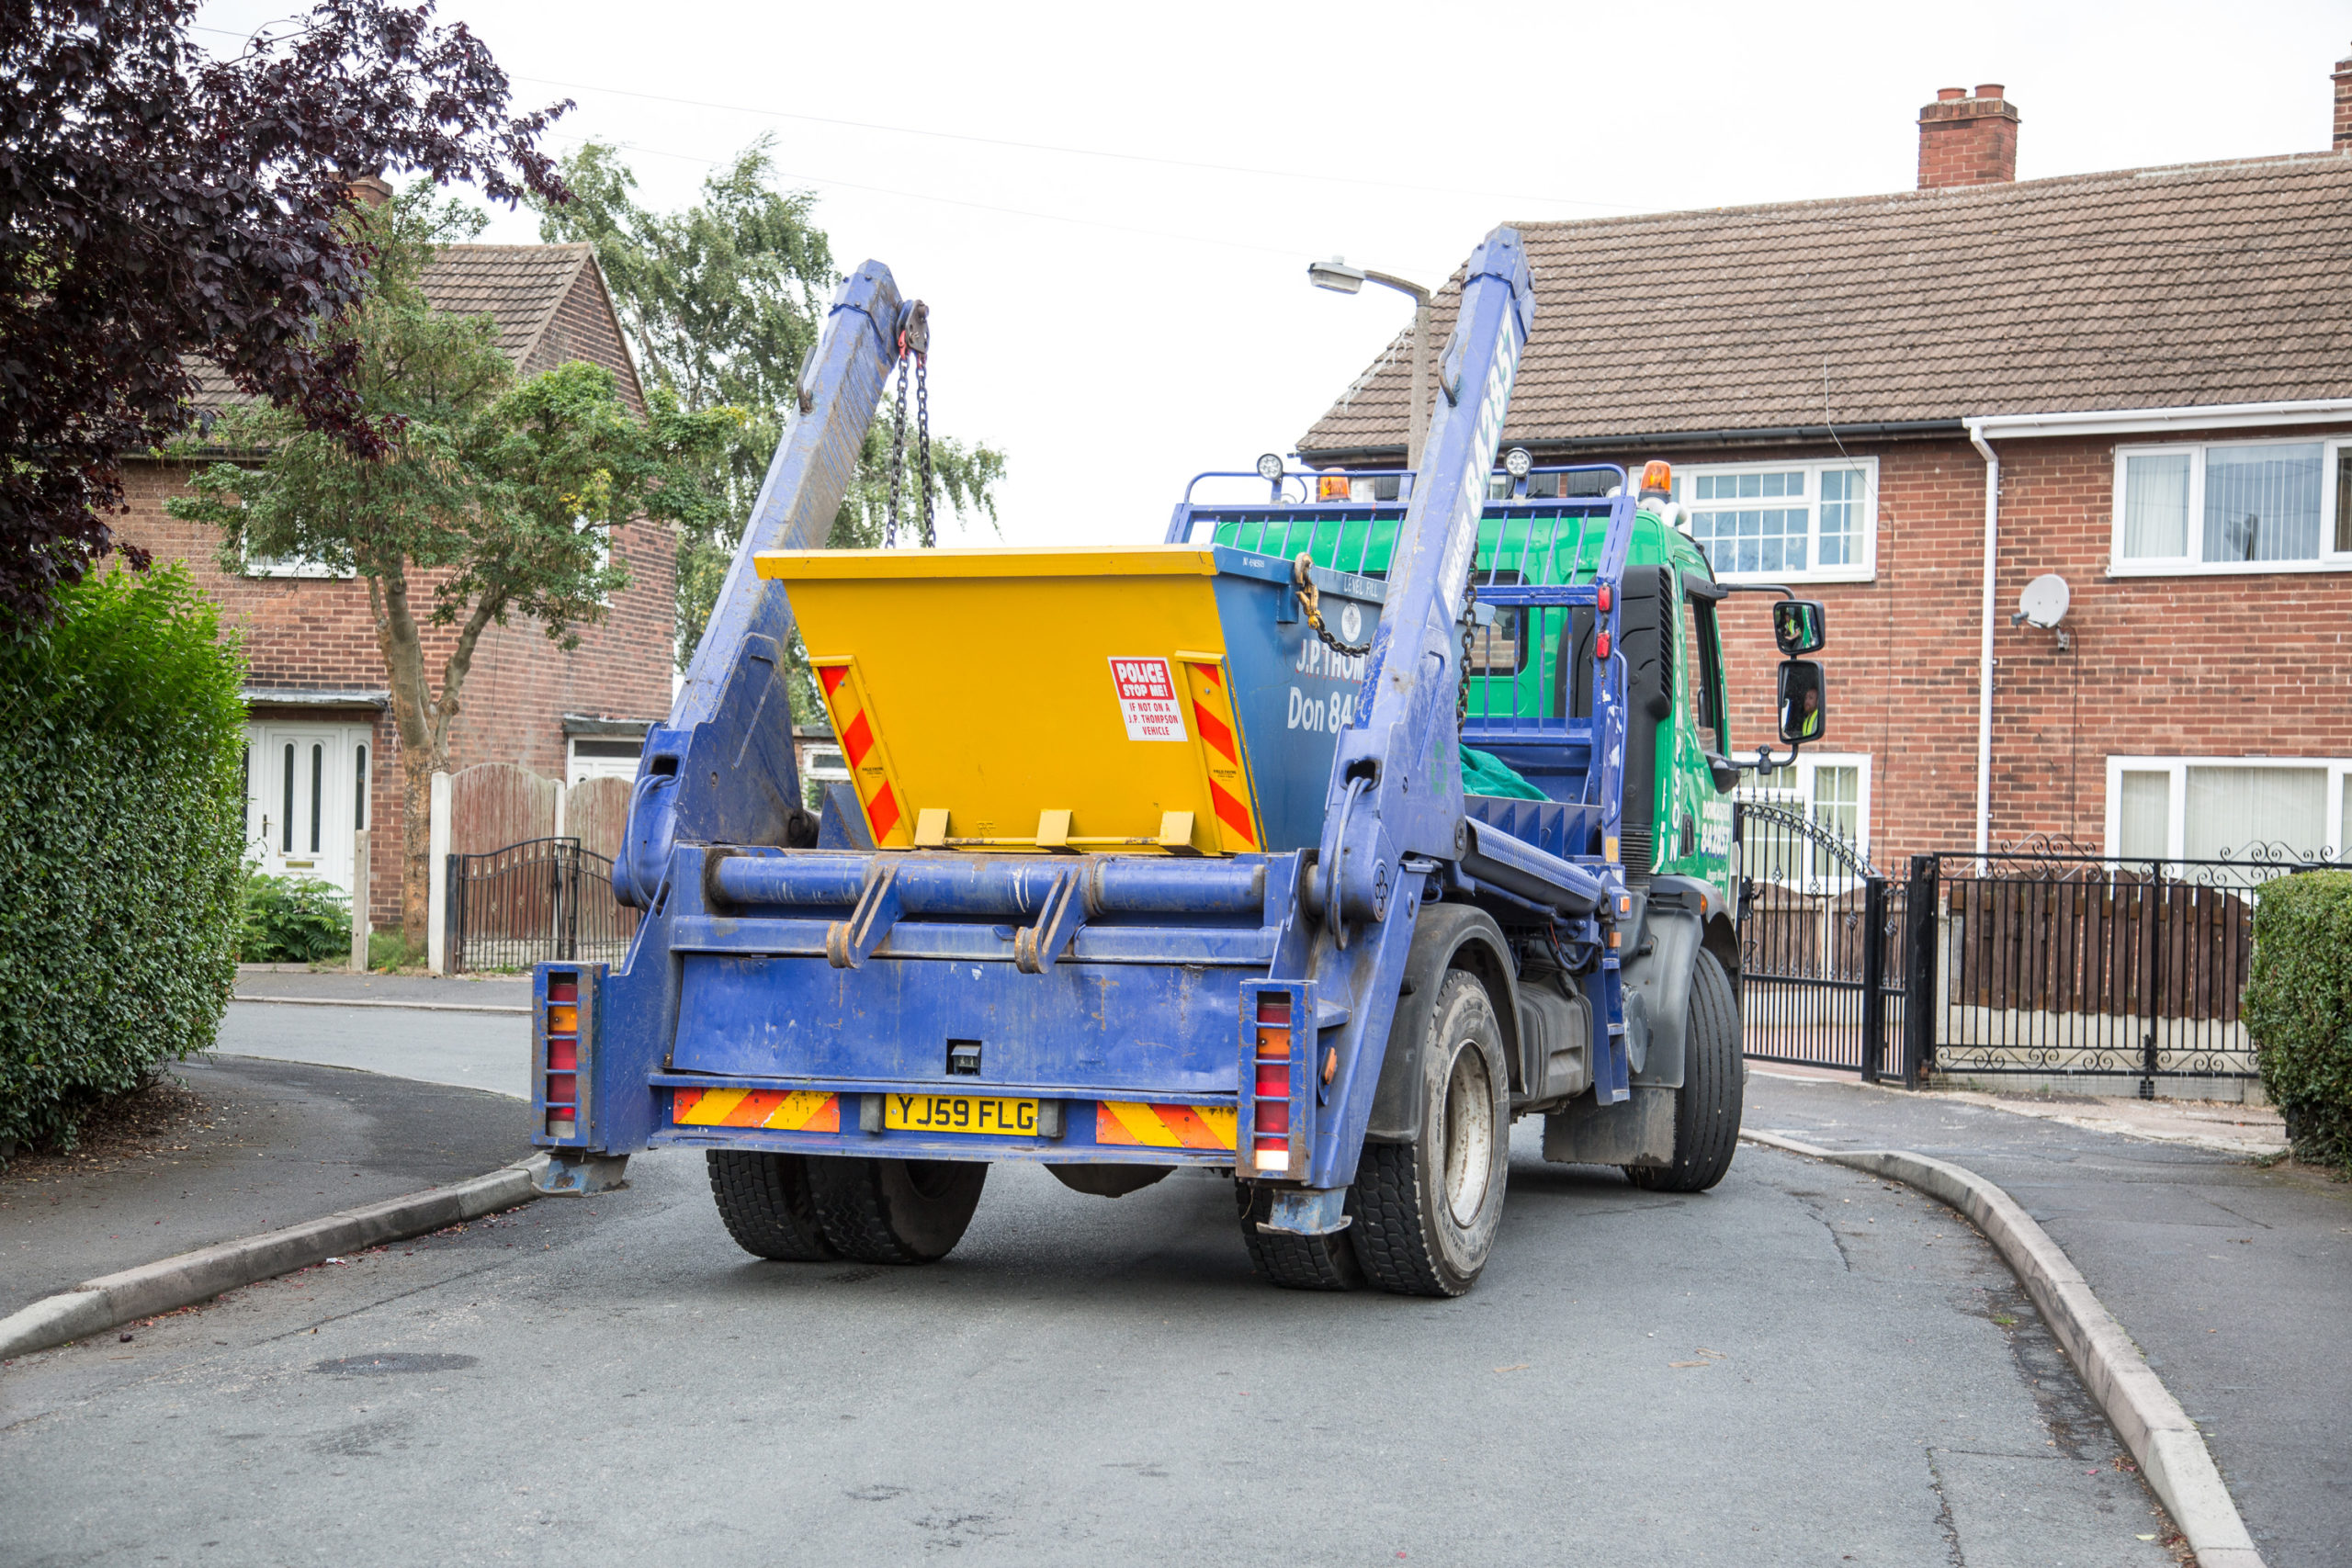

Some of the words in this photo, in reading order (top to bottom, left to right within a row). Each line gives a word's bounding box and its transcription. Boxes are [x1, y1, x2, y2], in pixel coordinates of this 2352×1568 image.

[1464, 303, 1517, 518] 842857
[1366, 581, 1378, 597] FILL
[1115, 662, 1166, 683] POLICE
[1123, 684, 1148, 697] STOP
[1149, 685, 1169, 697] ME!
[1129, 703, 1136, 712] IF
[1138, 703, 1152, 712] NOT
[1153, 703, 1163, 712] ON
[1165, 703, 1171, 712] A
[1287, 686, 1325, 732] Don
[1329, 691, 1359, 734] 84
[1128, 715, 1141, 724] J.P.
[1142, 715, 1179, 724] THOMPSON
[1142, 726, 1170, 736] VEHICLE
[1701, 824, 1731, 856] 842857
[898, 1097, 969, 1127] YJ59
[978, 1100, 1034, 1130] FLG
